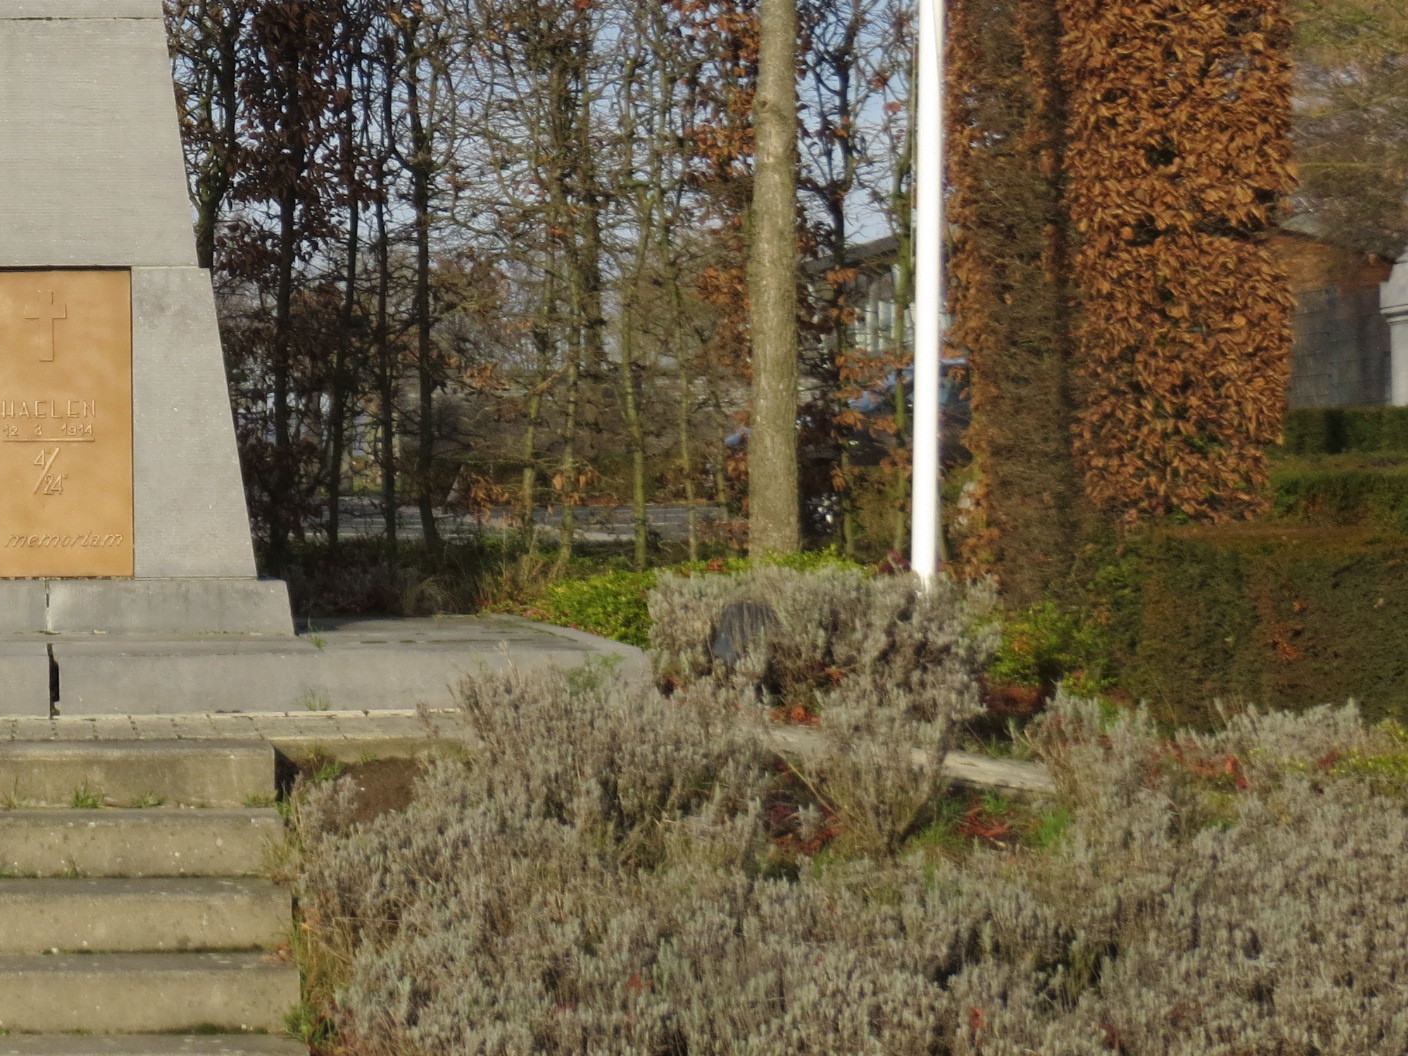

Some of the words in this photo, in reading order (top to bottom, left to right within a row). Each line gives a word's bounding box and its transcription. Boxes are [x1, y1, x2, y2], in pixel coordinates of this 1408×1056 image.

[1, 400, 96, 419] HAELEN
[3, 425, 19, 437] 12
[61, 422, 94, 437] 1914
[4, 530, 124, 548] memoriam
